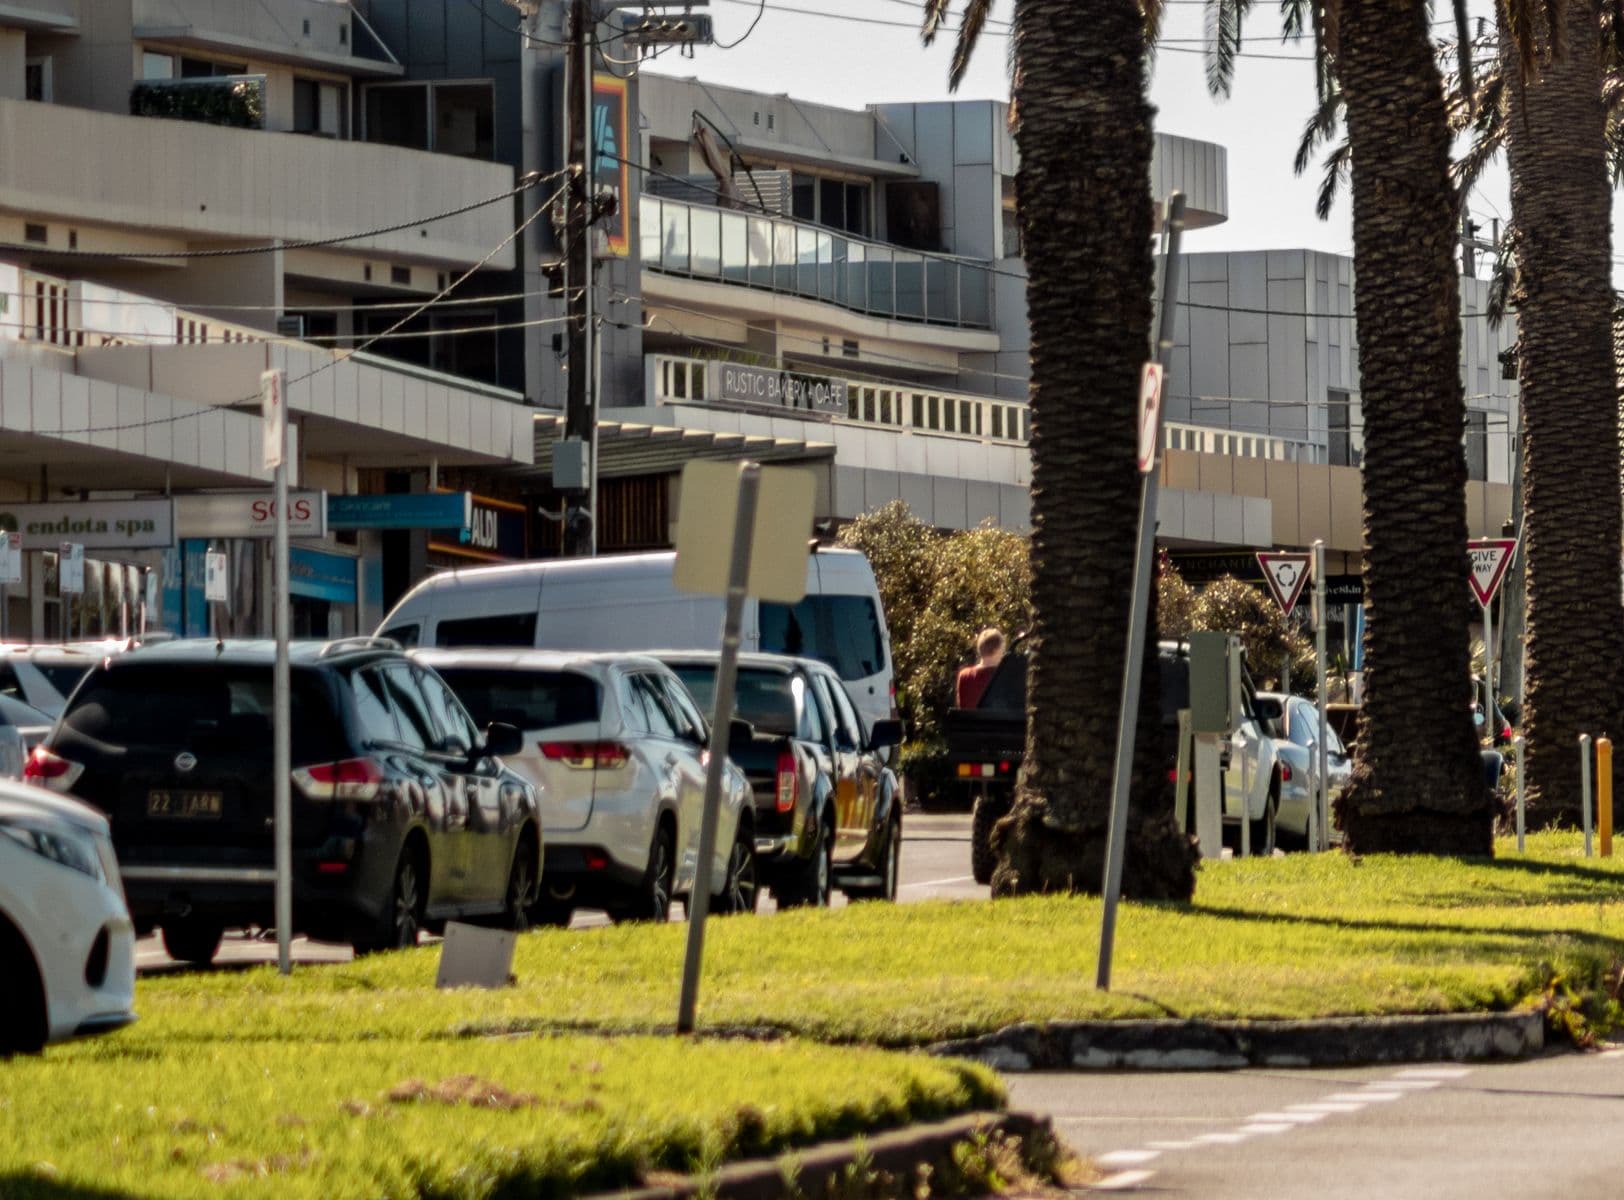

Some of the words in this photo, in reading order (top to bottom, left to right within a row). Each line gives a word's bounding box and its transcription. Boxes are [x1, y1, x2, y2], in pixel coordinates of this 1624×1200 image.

[726, 370, 765, 396] RUSTIC
[768, 377, 807, 401] BAKERY
[27, 515, 108, 535] endota
[115, 517, 155, 537] spa
[472, 507, 498, 548] ALDI
[1471, 551, 1497, 562] GIVE
[1475, 563, 1492, 573] WAY
